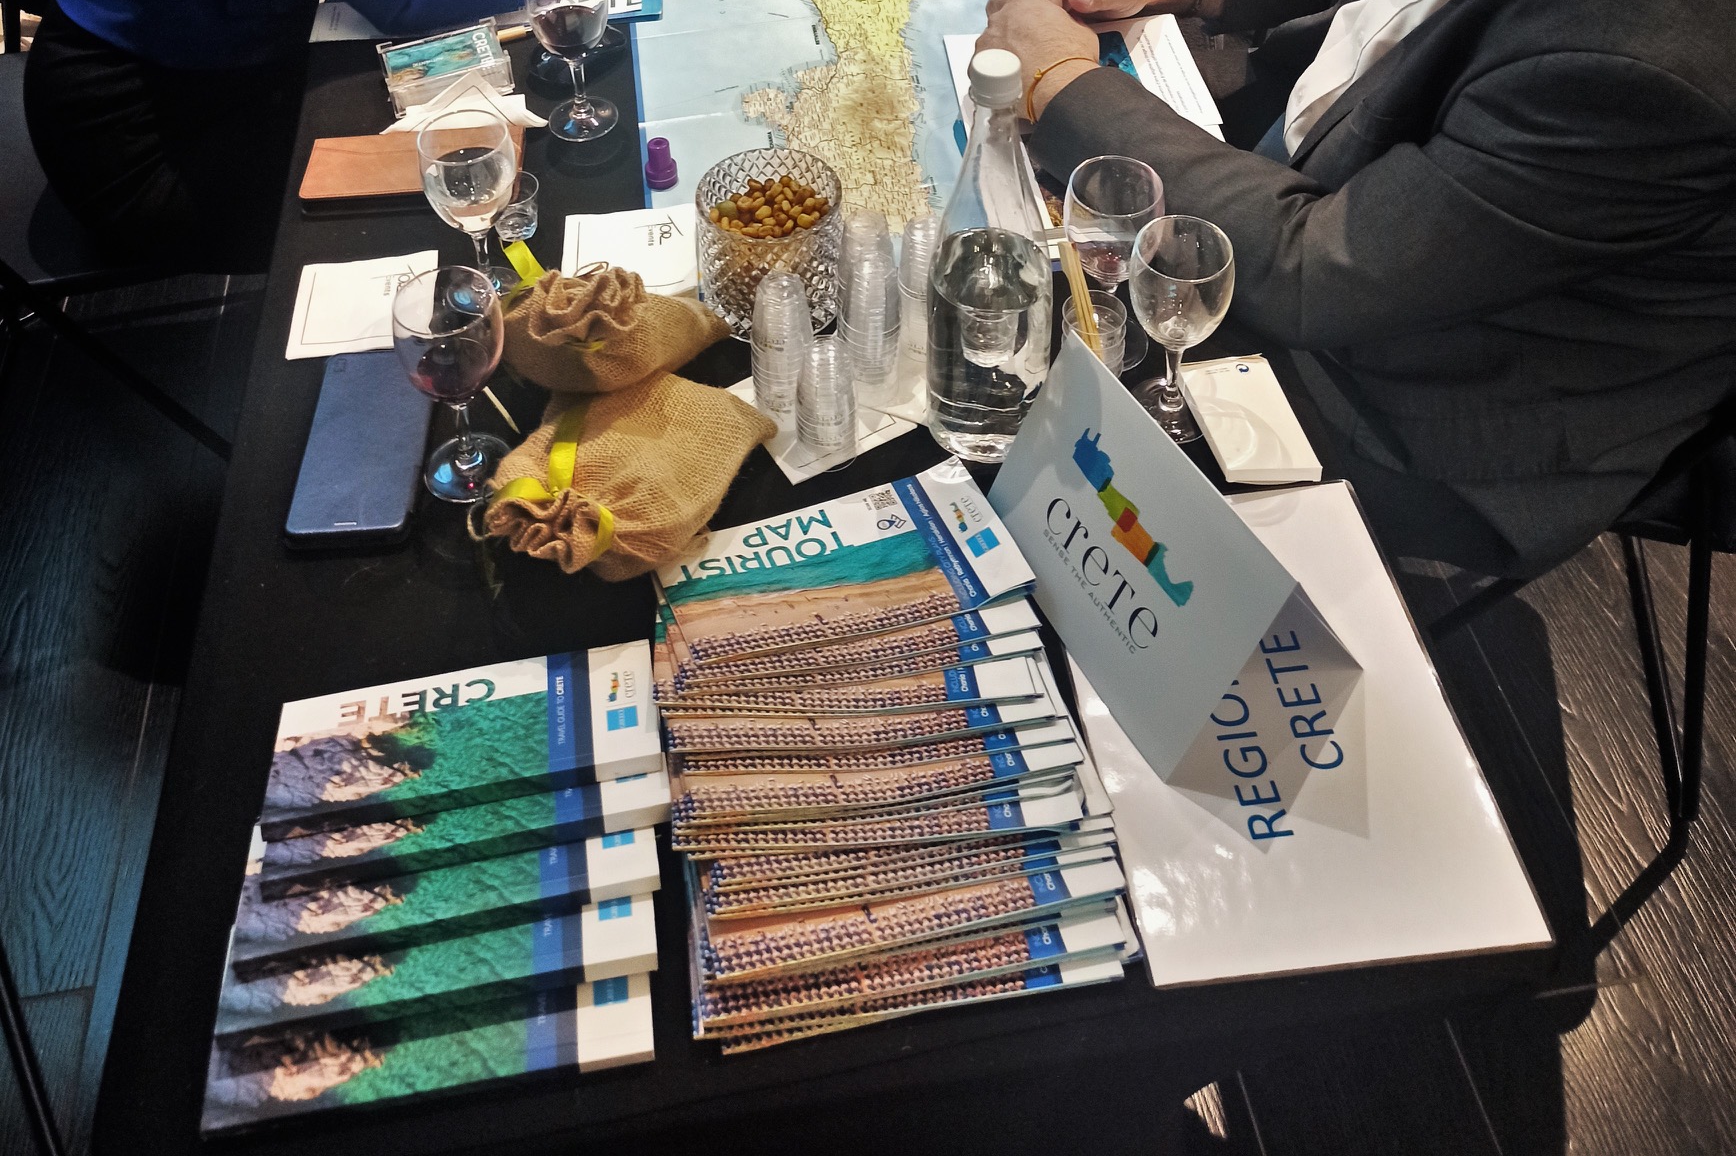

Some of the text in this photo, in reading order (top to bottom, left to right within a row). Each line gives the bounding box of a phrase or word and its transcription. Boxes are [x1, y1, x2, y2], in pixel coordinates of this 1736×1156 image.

[742, 509, 834, 548] MAP
[928, 520, 945, 544] Heraklion
[677, 531, 854, 583] TOURIST
[944, 546, 963, 576] Rethymnon
[1046, 498, 1159, 650] crete
[962, 578, 977, 597] Chania
[1042, 528, 1136, 655] SENSE THE AUTHENTIC
[337, 678, 496, 728] CRETE
[555, 675, 565, 695] CRETE
[1260, 629, 1345, 770] CRETE
[557, 705, 566, 723] GUIDE
[557, 723, 566, 745] TRAVEL
[1209, 679, 1294, 841] REGIO
